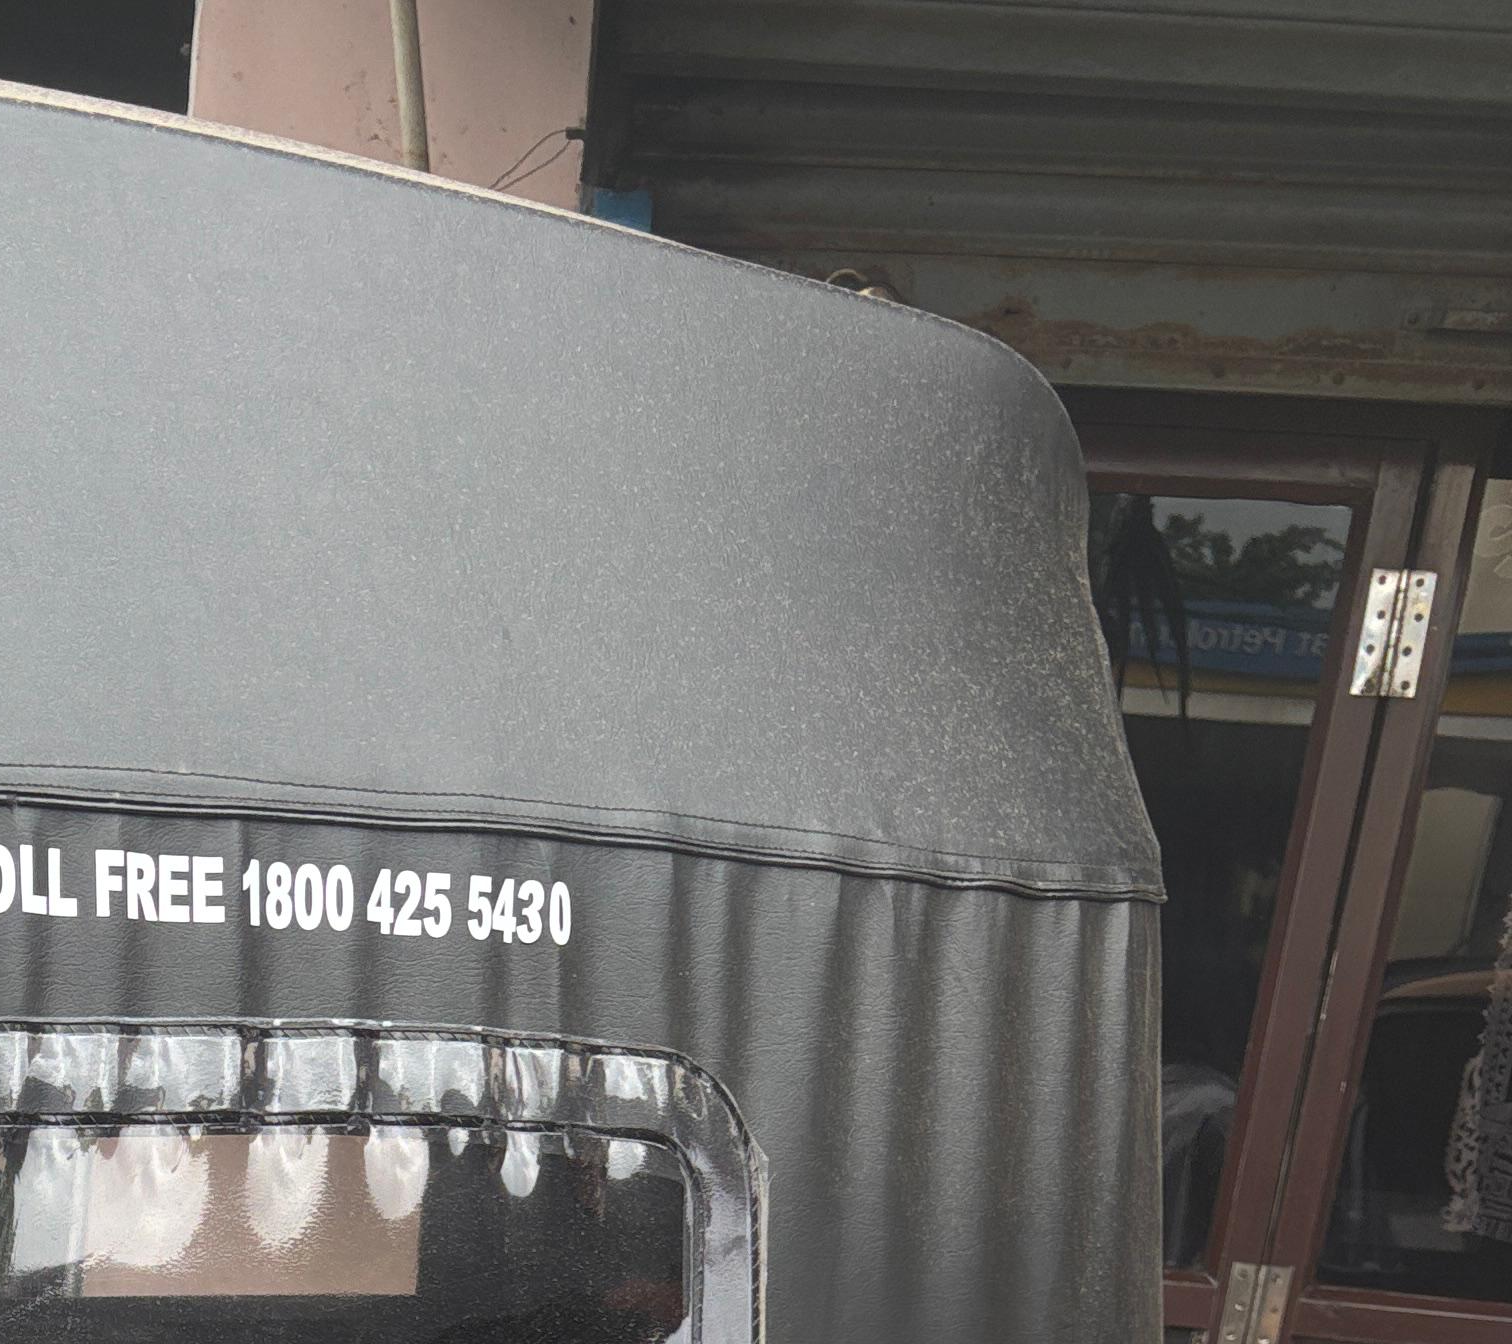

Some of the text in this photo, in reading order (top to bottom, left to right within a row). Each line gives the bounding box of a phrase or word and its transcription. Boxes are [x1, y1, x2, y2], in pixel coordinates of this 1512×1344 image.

[95, 849, 226, 923] FREE
[242, 858, 354, 930] 1800
[367, 868, 452, 938] 425
[467, 875, 572, 945] 5430
